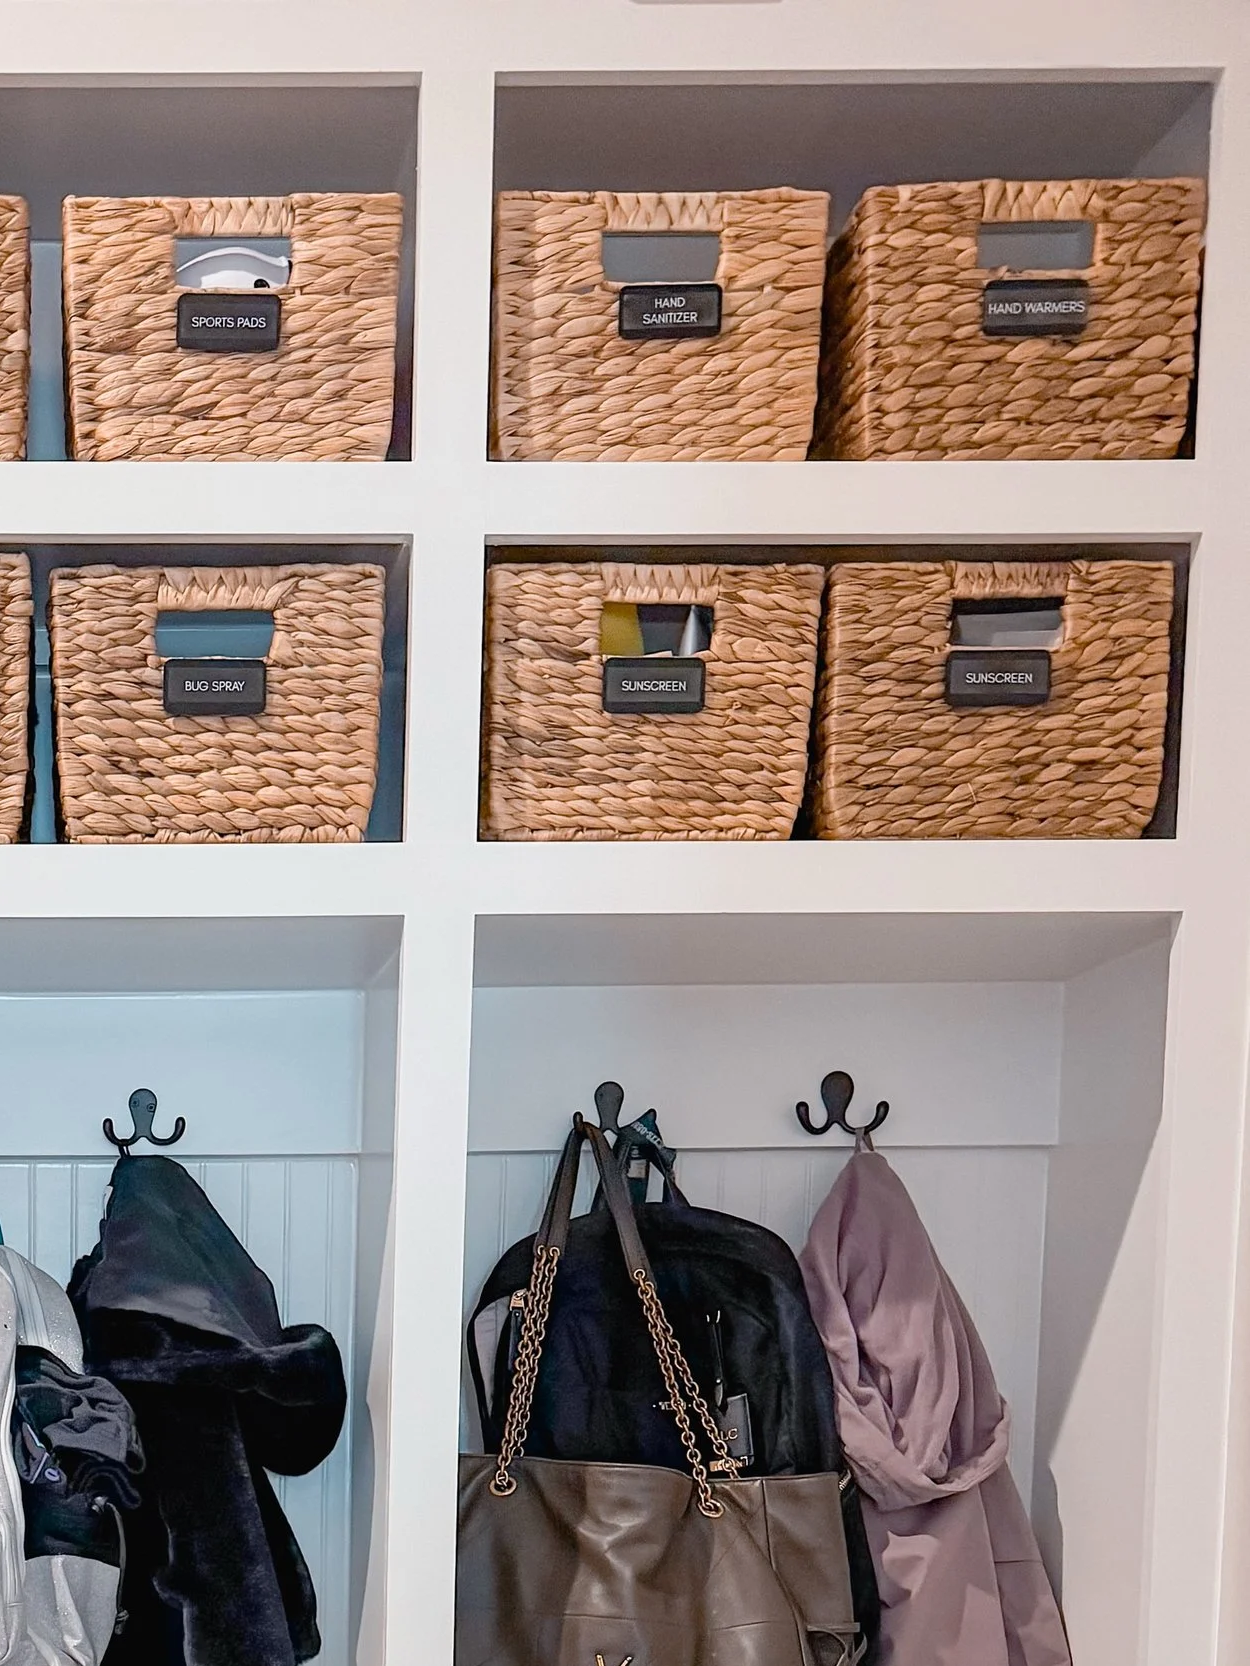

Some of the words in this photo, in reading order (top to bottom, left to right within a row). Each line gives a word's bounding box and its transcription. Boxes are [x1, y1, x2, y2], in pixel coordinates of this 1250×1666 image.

[654, 296, 686, 309] HAND
[988, 302, 1022, 314] HAND
[1025, 300, 1086, 314] WARMERS
[191, 316, 234, 329] SPORTS
[237, 316, 266, 329] PADS
[642, 311, 698, 325] SANITIZER
[965, 672, 1033, 685] SUNSCREEN
[184, 680, 209, 692] BUG
[212, 680, 246, 693] SPRAY
[621, 680, 687, 692] SUNSCREEN
